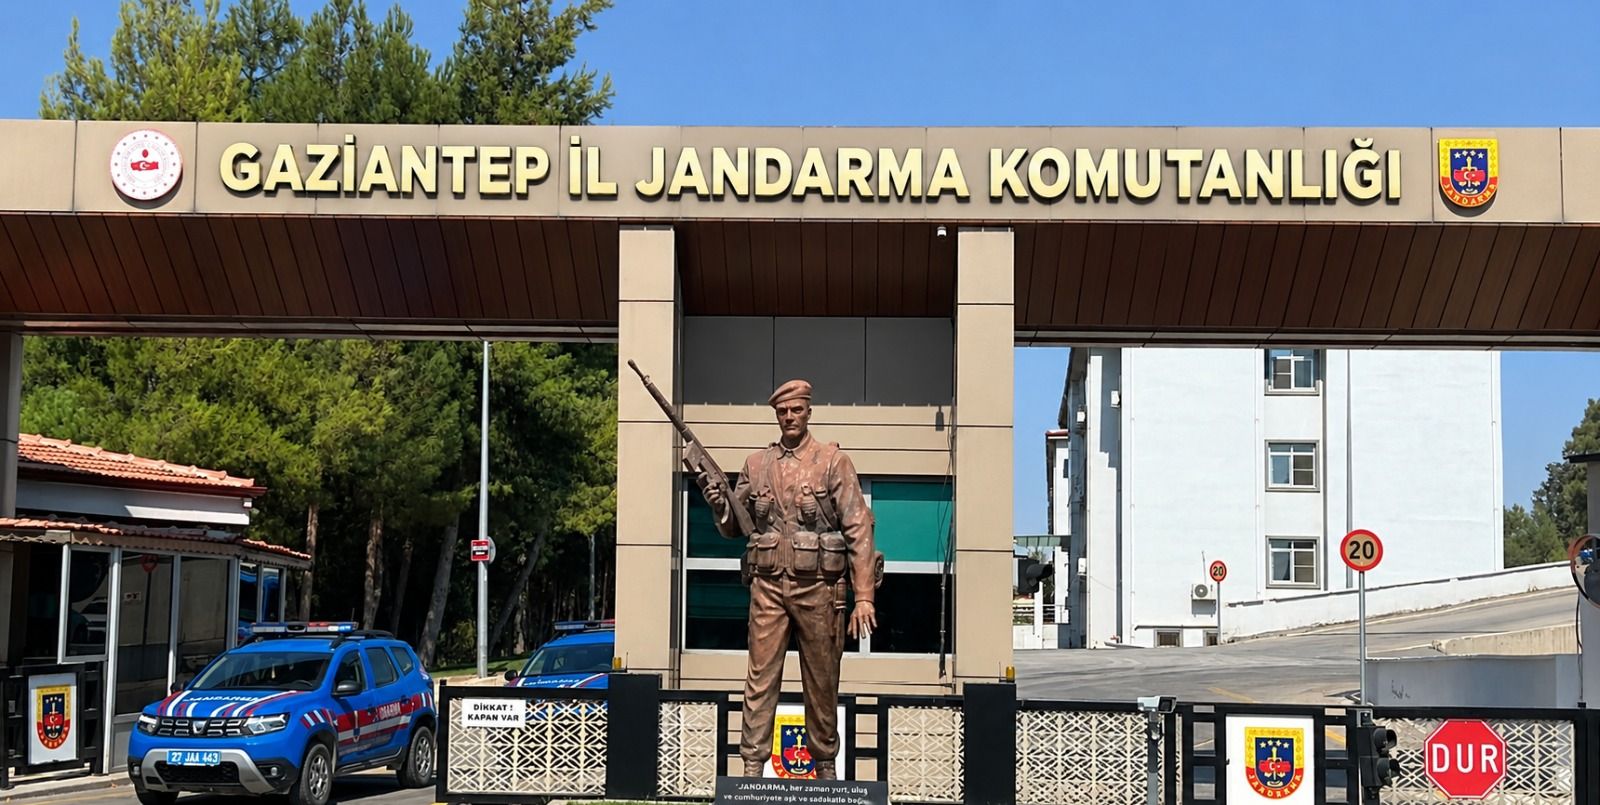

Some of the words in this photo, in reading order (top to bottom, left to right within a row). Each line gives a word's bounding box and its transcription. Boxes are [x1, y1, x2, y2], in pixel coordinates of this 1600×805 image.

[219, 134, 550, 196] GAZİANTEP
[569, 135, 618, 197] İL
[635, 147, 970, 200] JANDARMA
[990, 137, 1401, 202] KOMUTANLIĞI
[1349, 540, 1375, 560] 20
[1212, 566, 1224, 577] 20
[473, 702, 508, 711] DİKKAT
[467, 713, 499, 721] KAPAN
[171, 752, 182, 762] 27
[185, 752, 199, 762] JAA
[1432, 743, 1498, 773] DUR
